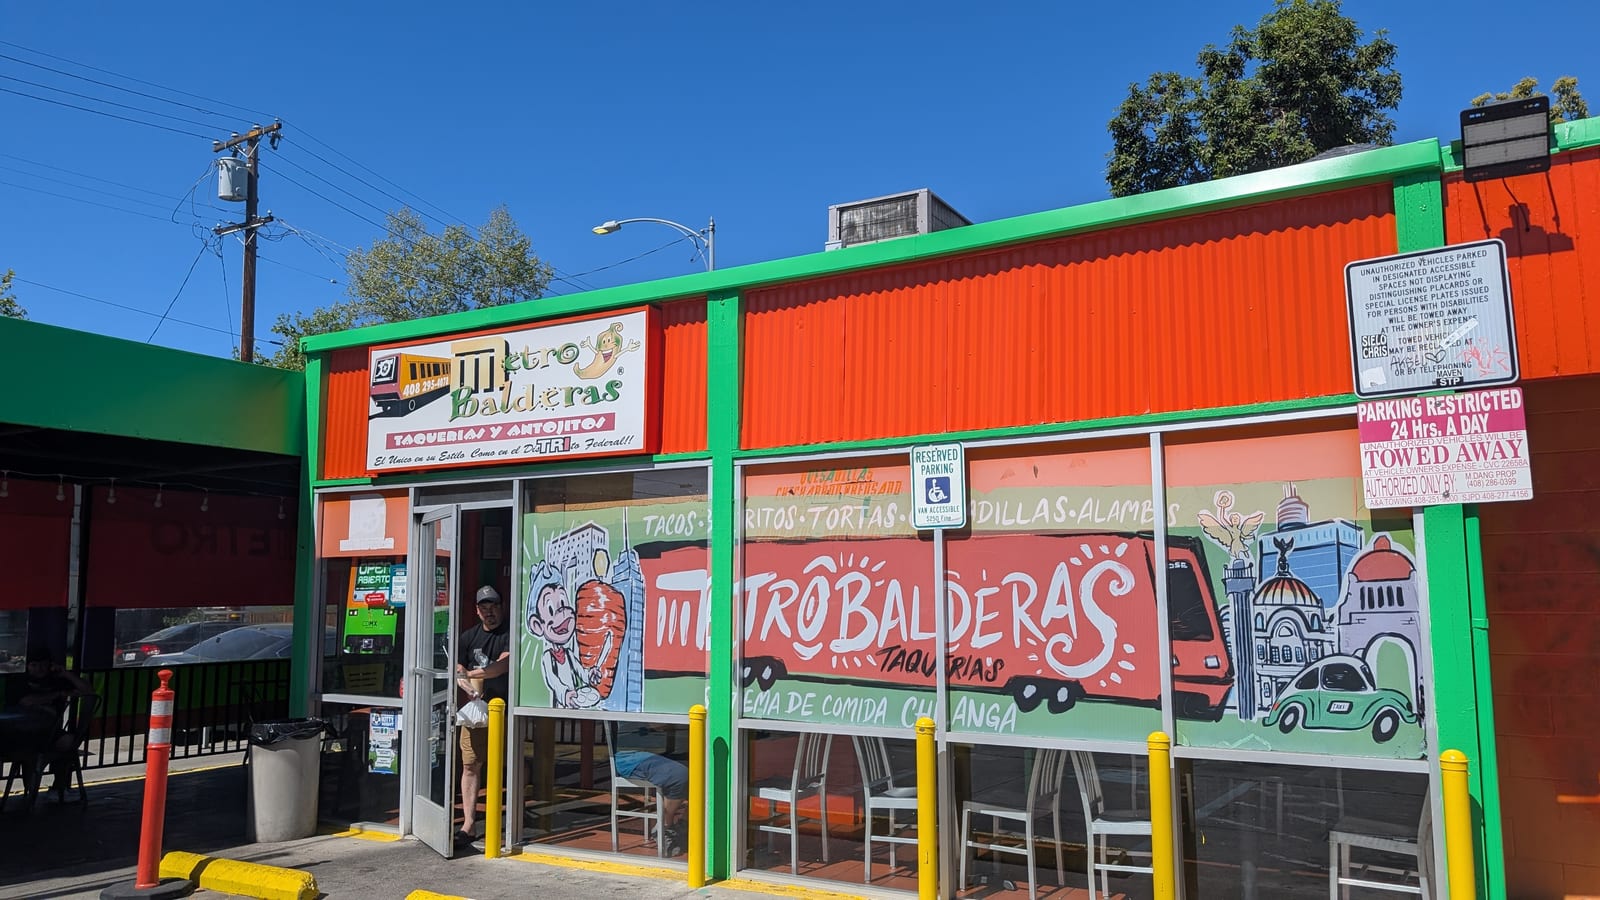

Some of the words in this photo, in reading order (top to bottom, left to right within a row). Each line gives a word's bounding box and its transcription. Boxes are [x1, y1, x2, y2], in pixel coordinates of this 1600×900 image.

[1360, 263, 1416, 276] UNAUTHORIZED
[1418, 254, 1454, 267] VEHICLES
[1456, 249, 1488, 261] PARKED
[1372, 275, 1380, 283] IN
[1382, 268, 1427, 281] DESIGNATED
[1430, 260, 1477, 274] ACCESSIBLE
[1369, 286, 1428, 301] DISTINGUISHING
[1430, 280, 1470, 292] PLACARDS
[1472, 277, 1484, 286] OR
[1378, 280, 1407, 291] SPACES
[1409, 277, 1423, 287] NOT
[1426, 270, 1471, 283] DISPLAYING
[1365, 300, 1397, 310] SPECIAL
[1397, 294, 1428, 306] LICENSE
[1431, 290, 1460, 301] PLATES
[1461, 286, 1490, 296] ISSUED
[1367, 310, 1382, 319] FOR
[1384, 305, 1418, 316] PERSONS
[1420, 303, 1438, 311] WITH
[1440, 295, 1489, 309] DISABILITIES
[1388, 316, 1405, 325] WILL
[1407, 313, 1417, 322] BE
[1420, 310, 1445, 320] TOWED
[1447, 307, 1468, 317] AWAY
[1381, 326, 1390, 334] AT
[1391, 324, 1406, 333] THE
[1408, 319, 1441, 331] OWNER'S
[1361, 333, 1387, 346] SIELO
[1389, 346, 1404, 354] MAY
[1419, 339, 1462, 351] RECLAED
[1398, 335, 1423, 345] TOWED
[1362, 345, 1388, 359] CHRIS
[450, 336, 580, 394] Metro
[1394, 368, 1405, 377] OR
[1407, 366, 1417, 375] BY
[1420, 361, 1473, 374] TELEPHONING
[1436, 368, 1463, 378] MAVEN
[402, 382, 421, 397] 408
[1440, 377, 1461, 387] STP
[449, 378, 624, 422] Balderas
[1358, 398, 1423, 423] PARKING
[1425, 388, 1522, 417] RESTRICTED
[393, 426, 485, 447] TAQUERIAS
[490, 426, 503, 439] Y
[506, 415, 606, 437] ANTOJITOS
[1390, 420, 1409, 441] 24
[1411, 417, 1442, 439] Hrs.
[1445, 417, 1459, 436] A
[1462, 413, 1490, 434] DAY
[1363, 438, 1435, 450] UNAUTHORIZED
[1436, 435, 1483, 444] VEHICLES
[1485, 432, 1508, 441] WILL
[1509, 431, 1523, 439] BE
[374, 455, 387, 467] El
[389, 455, 412, 465] Unico
[438, 450, 466, 462] Estilo
[470, 447, 495, 459] Como
[511, 446, 521, 454] el
[585, 435, 635, 451] Federal!!
[915, 448, 959, 464] RESERVED
[1364, 444, 1450, 470] TOWED
[1456, 438, 1524, 463] AWAY
[920, 462, 954, 475] PARKING
[1364, 469, 1372, 477] AT
[1374, 468, 1405, 476] VEHICLE
[1406, 464, 1441, 474] OWNER'S
[1441, 461, 1478, 472] EXPENSE
[1483, 460, 1500, 469] CVC
[1495, 469, 1517, 478] PROP
[1365, 476, 1419, 498] AUTHORIZED
[1420, 474, 1442, 495] ONLY
[1466, 479, 1485, 488] (408)
[929, 504, 960, 514] ACCESSIBLE
[1384, 497, 1413, 505] TOWING
[643, 509, 698, 537] TACOS
[807, 502, 898, 531] TORTAS
[876, 644, 1004, 683] TAQURIAS
[786, 690, 816, 716] DE
[822, 694, 888, 724] COMIDA
